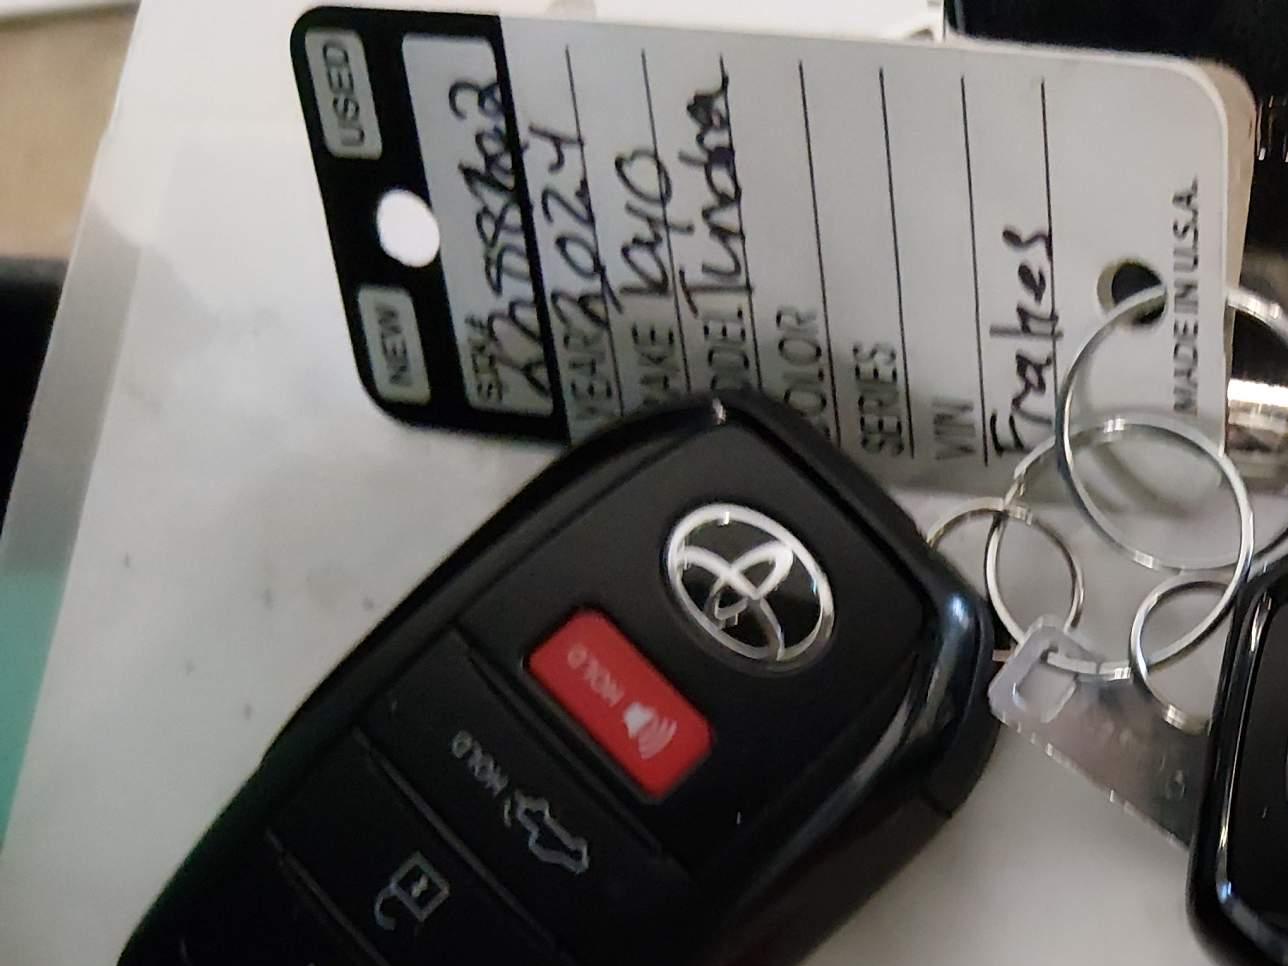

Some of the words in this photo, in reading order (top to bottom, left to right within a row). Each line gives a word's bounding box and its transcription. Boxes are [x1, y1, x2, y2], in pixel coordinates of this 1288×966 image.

[323, 40, 365, 147] USED
[530, 123, 611, 327] 2024
[1172, 278, 1199, 315] IN
[375, 305, 412, 387] NEW
[630, 320, 680, 408] AKE
[1172, 320, 1199, 416] MADE
[852, 342, 905, 456] SERIES
[931, 399, 977, 462] VIN
[567, 645, 625, 707] HOLD
[452, 730, 508, 796] HOLD
